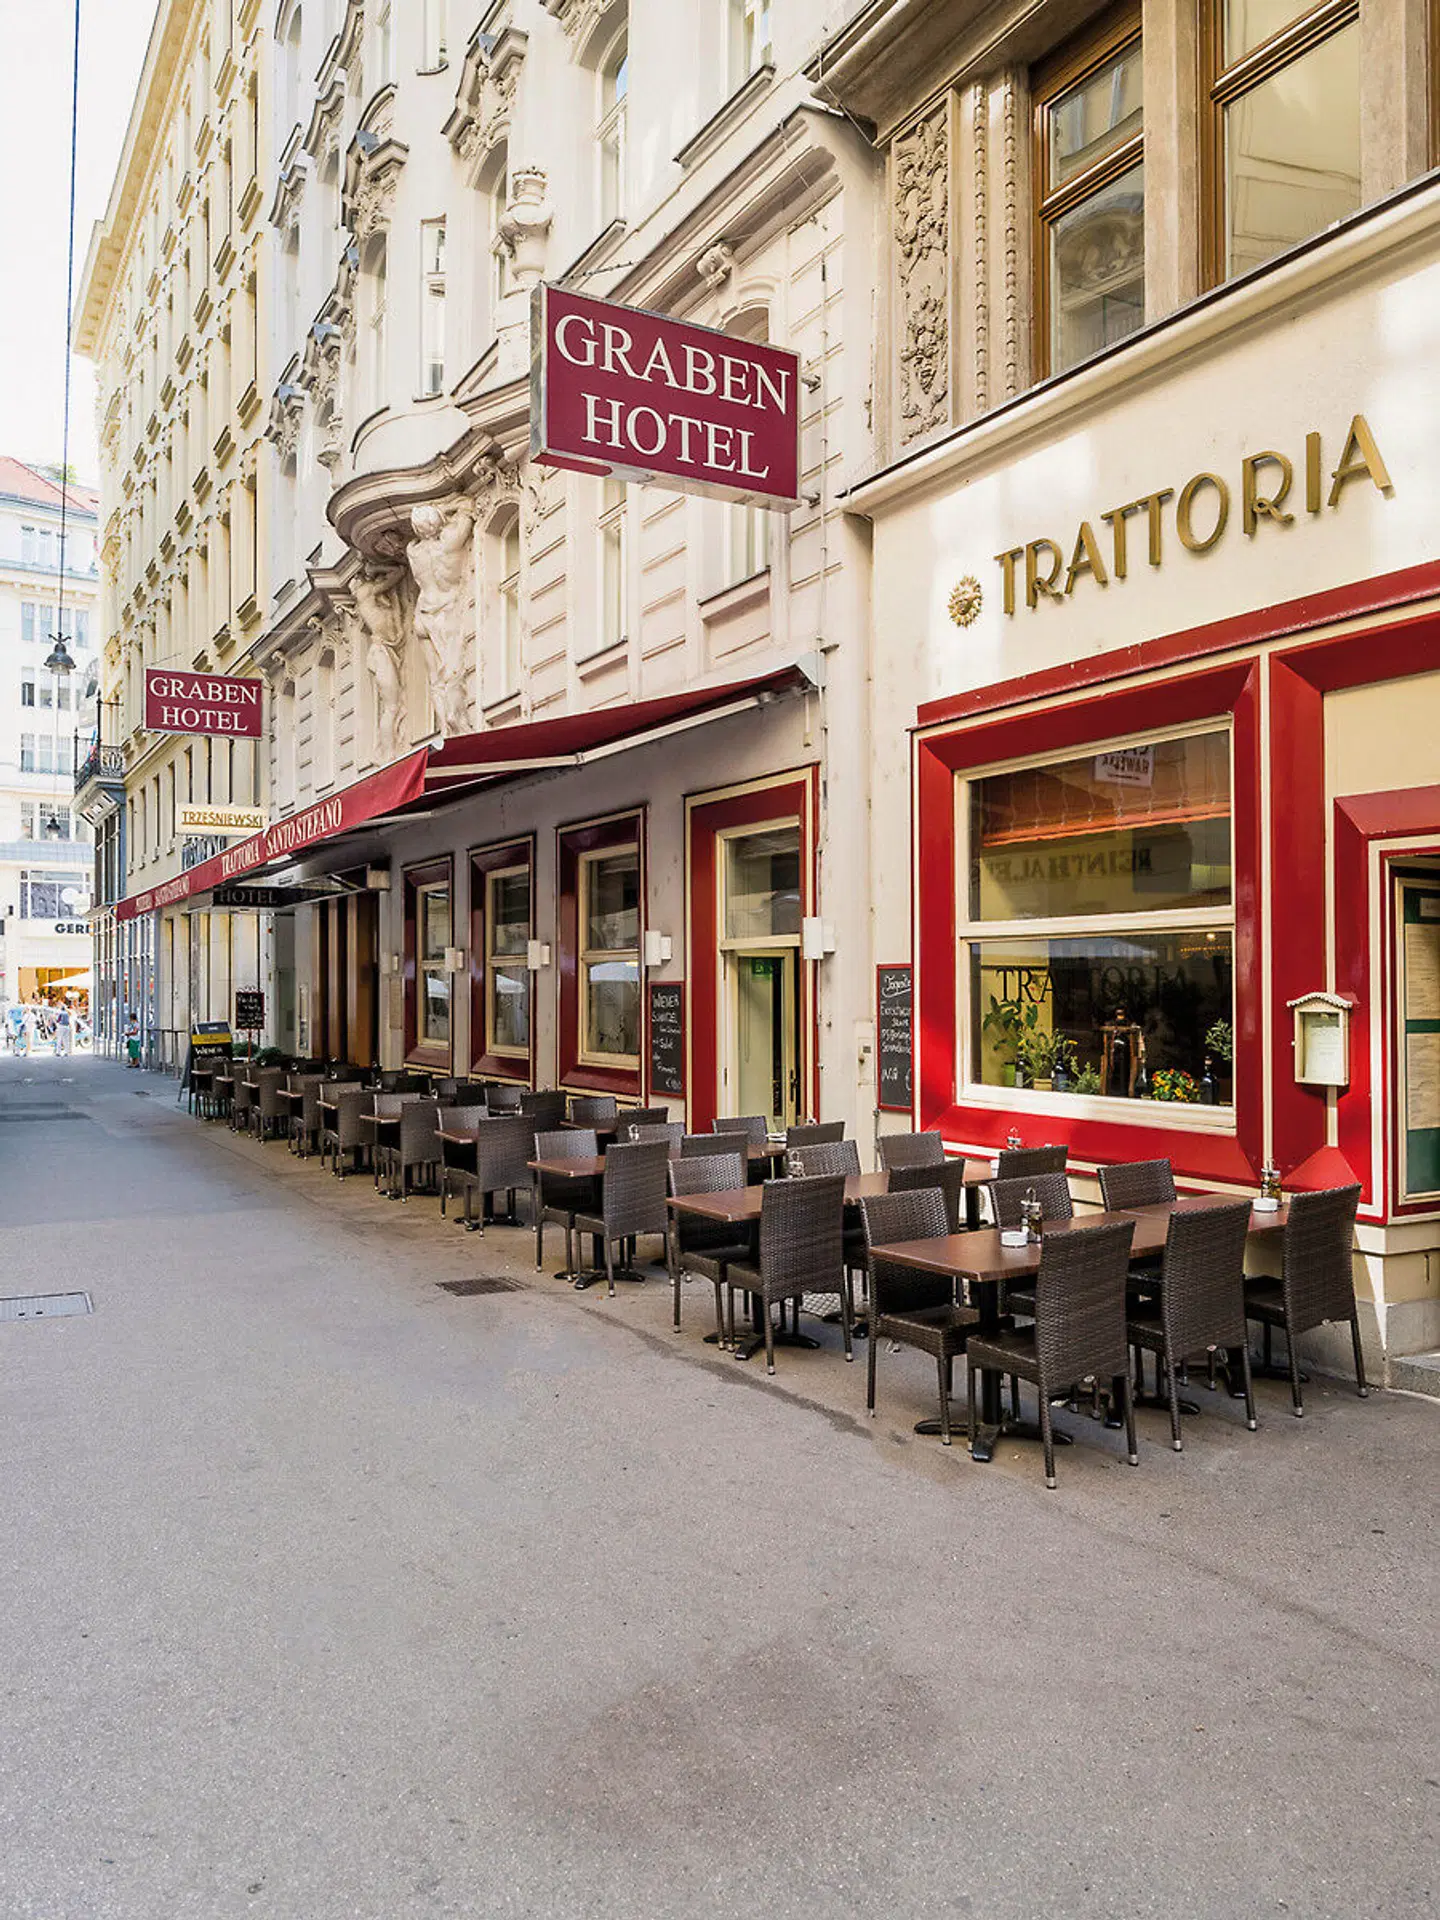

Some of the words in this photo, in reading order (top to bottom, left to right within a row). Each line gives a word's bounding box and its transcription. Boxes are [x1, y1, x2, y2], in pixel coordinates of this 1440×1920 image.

[554, 314, 791, 415] GRABEN
[580, 392, 770, 479] HOTEL
[993, 414, 1394, 615] TRATTORIA
[149, 676, 258, 705] GRABEN
[161, 705, 248, 731] HOTEL
[222, 839, 260, 878] TRATTORIA
[265, 820, 296, 857] SANTO
[295, 798, 343, 844] STEFANO
[219, 889, 278, 904] HOTEL
[995, 965, 1188, 1006] TRAORIA
